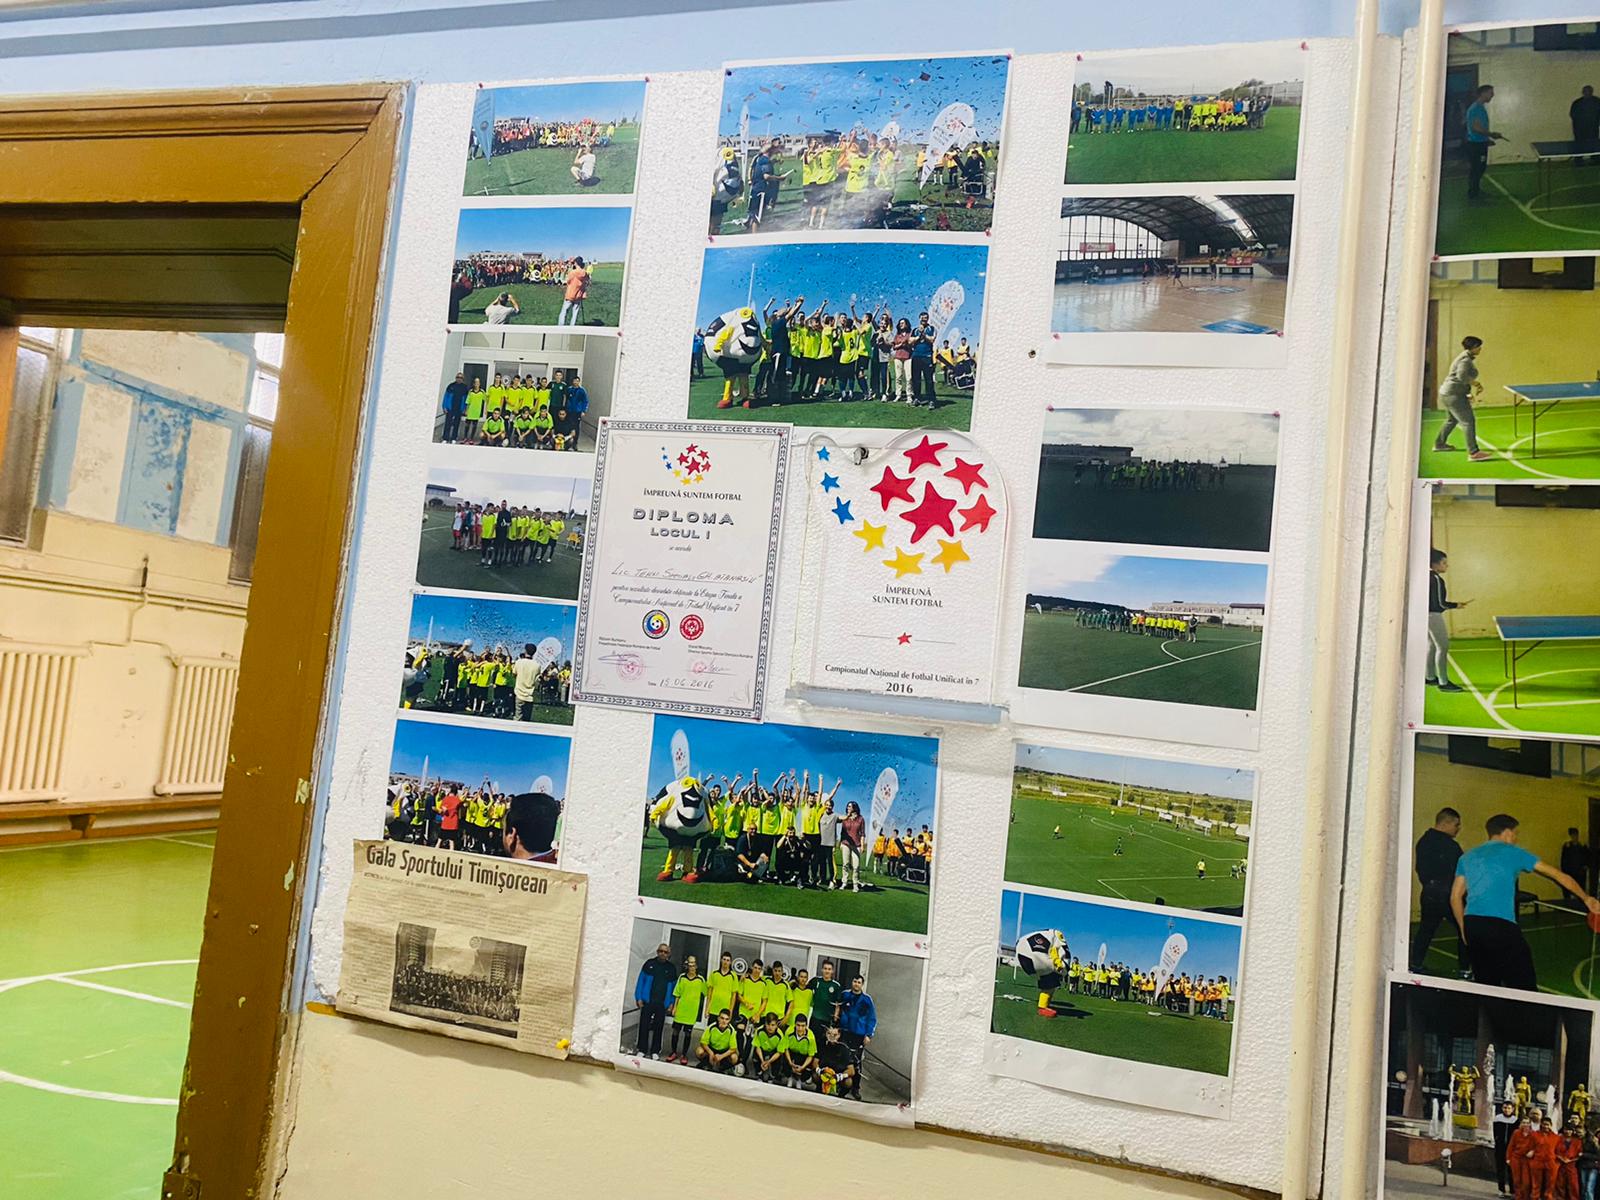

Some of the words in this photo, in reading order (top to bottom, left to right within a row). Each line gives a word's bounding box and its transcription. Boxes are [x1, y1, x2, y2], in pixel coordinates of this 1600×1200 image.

[683, 491, 714, 499] SUNTEM
[714, 492, 742, 501] FOTBAL
[633, 508, 734, 525] DIPLOMA
[650, 527, 700, 539] LOCUL
[872, 595, 908, 605] SUNTEM
[910, 598, 943, 608] FOTBAL
[825, 664, 868, 675] Campionatul
[901, 671, 910, 679] de
[911, 672, 933, 681] Fotbal
[935, 674, 964, 684] Unificat
[886, 682, 913, 694] 2016
[366, 844, 396, 868] Gala
[400, 849, 463, 880] Sportului
